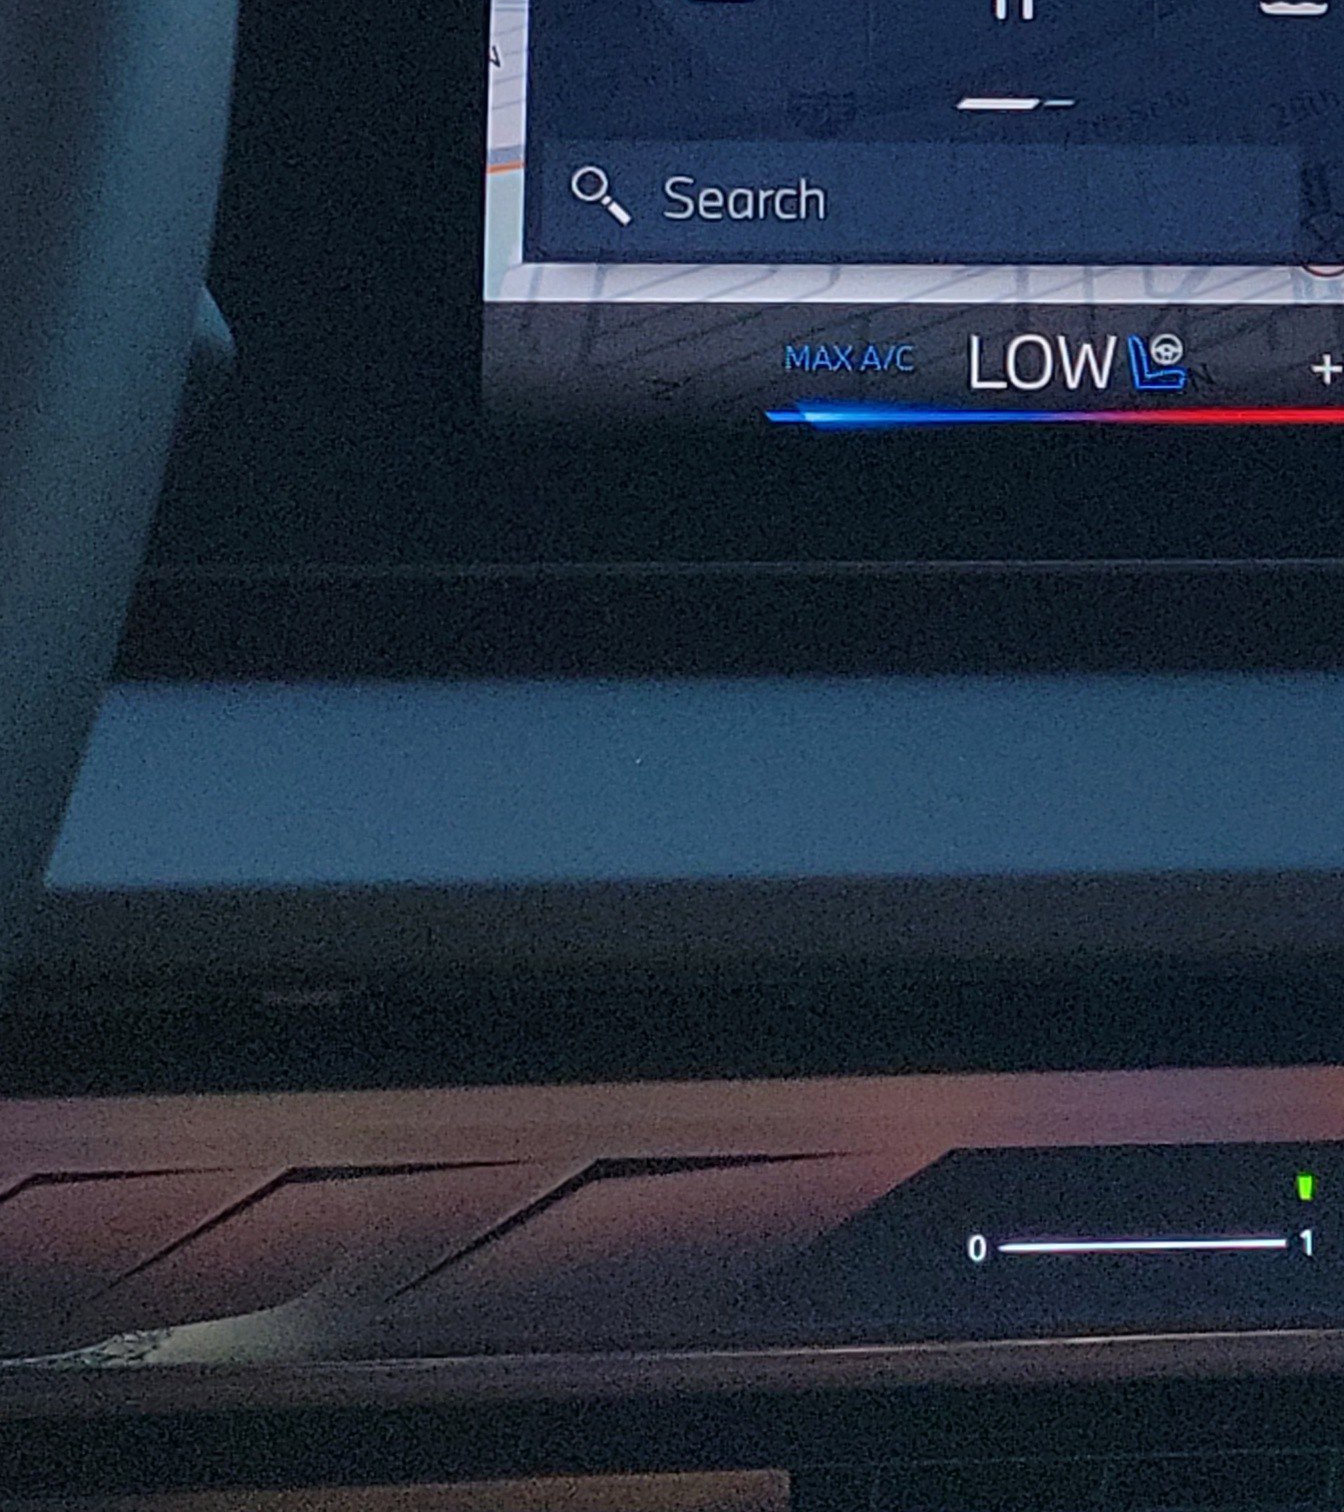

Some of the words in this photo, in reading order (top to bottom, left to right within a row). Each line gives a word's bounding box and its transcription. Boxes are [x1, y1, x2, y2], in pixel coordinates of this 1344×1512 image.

[663, 175, 827, 221] Search
[785, 344, 854, 372] MAX
[858, 344, 917, 372] A/C
[968, 333, 1118, 391] LOW
